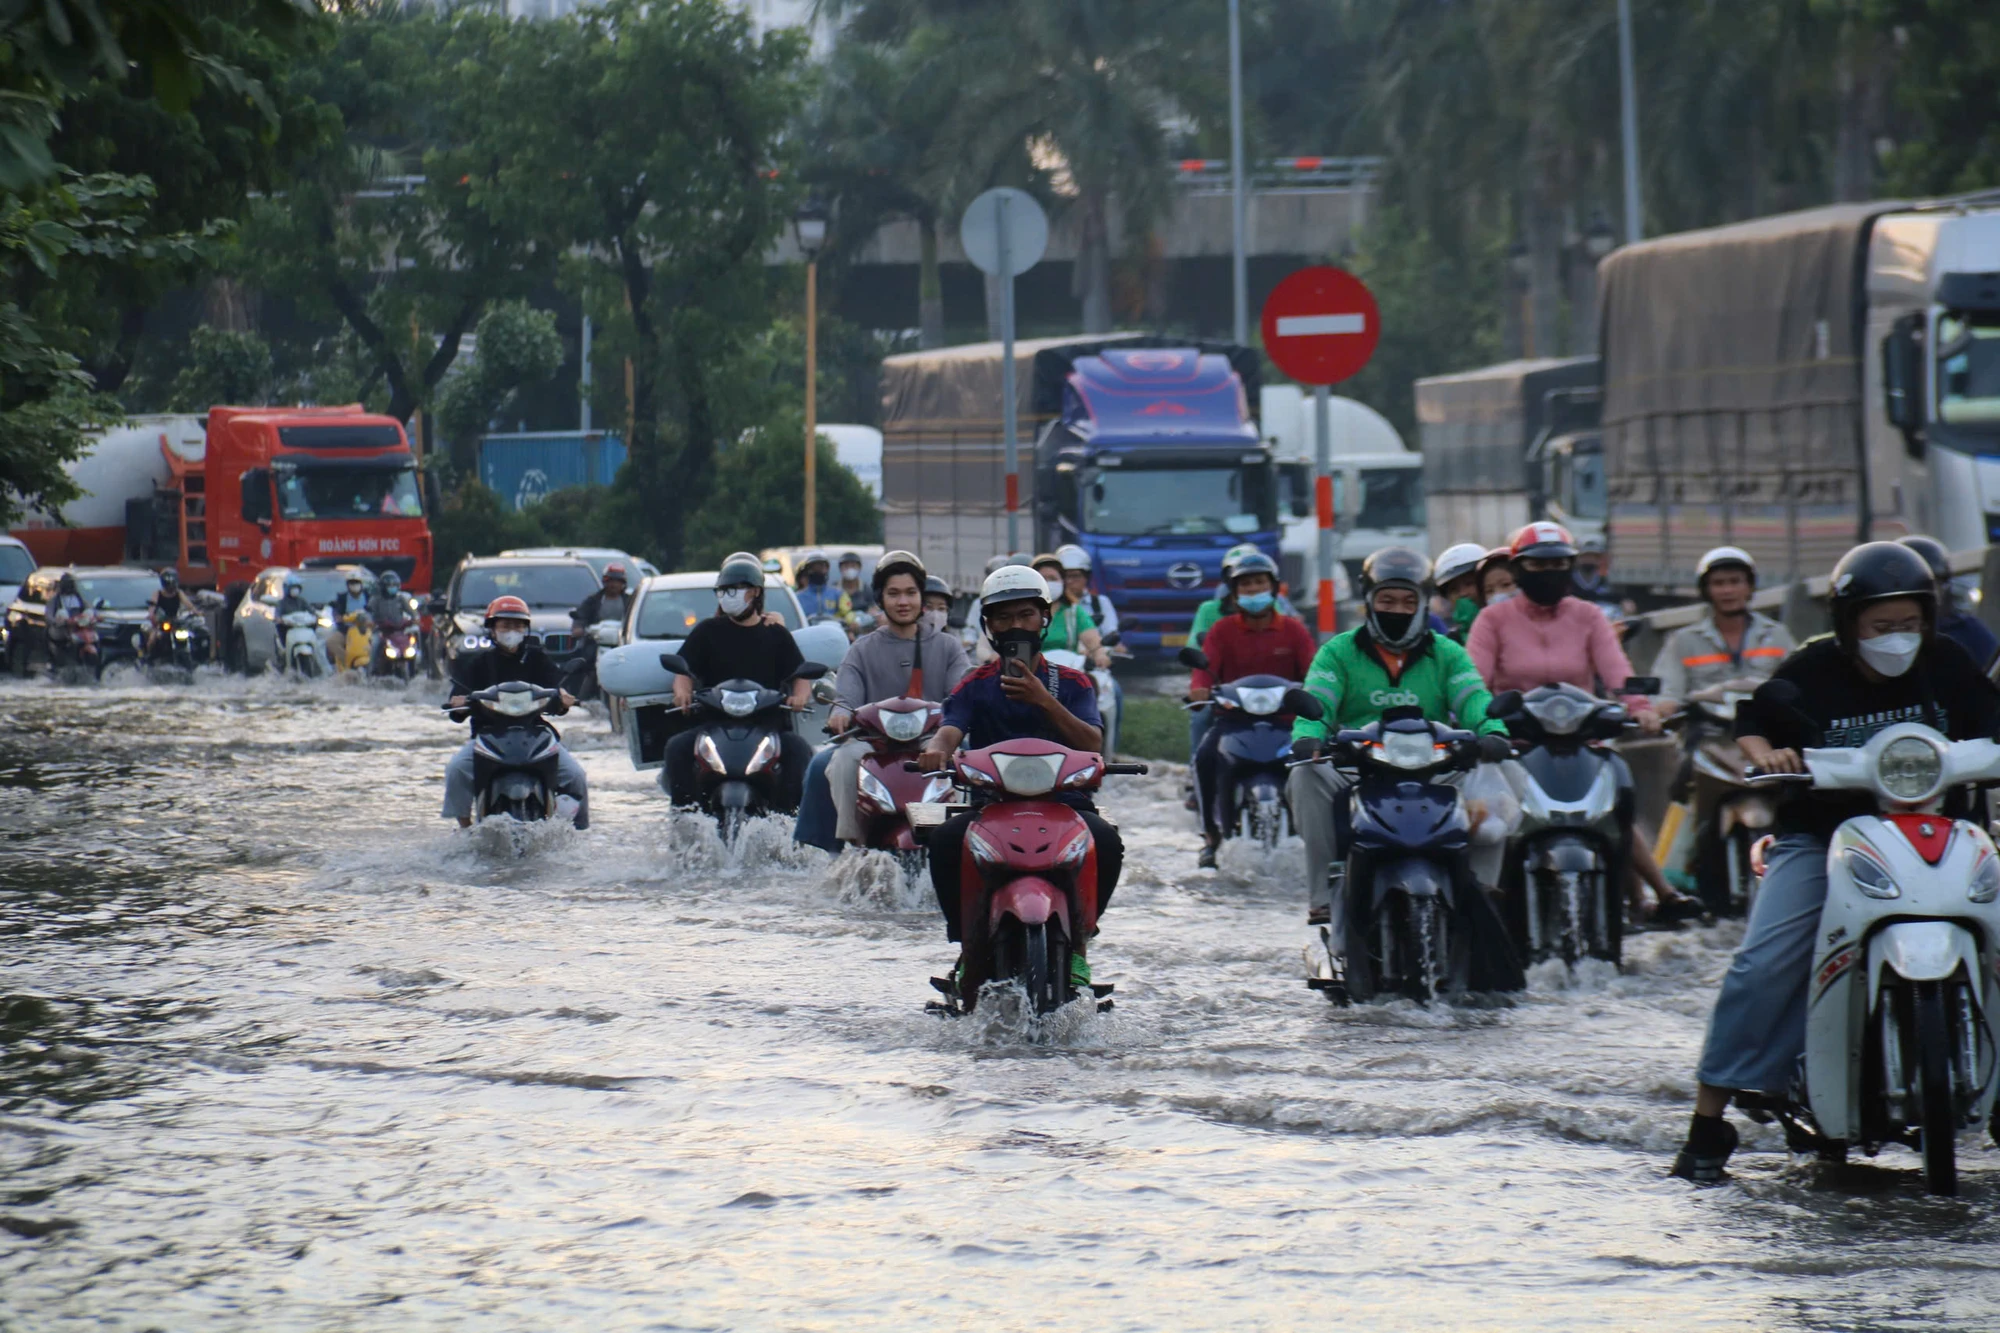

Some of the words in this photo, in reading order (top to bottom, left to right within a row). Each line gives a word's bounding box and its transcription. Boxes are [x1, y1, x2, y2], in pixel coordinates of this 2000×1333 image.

[319, 536, 356, 552] HOÀNG
[380, 538, 400, 551] FCC
[1369, 689, 1419, 706] Grab
[1831, 701, 1939, 729] PHILADELPH
